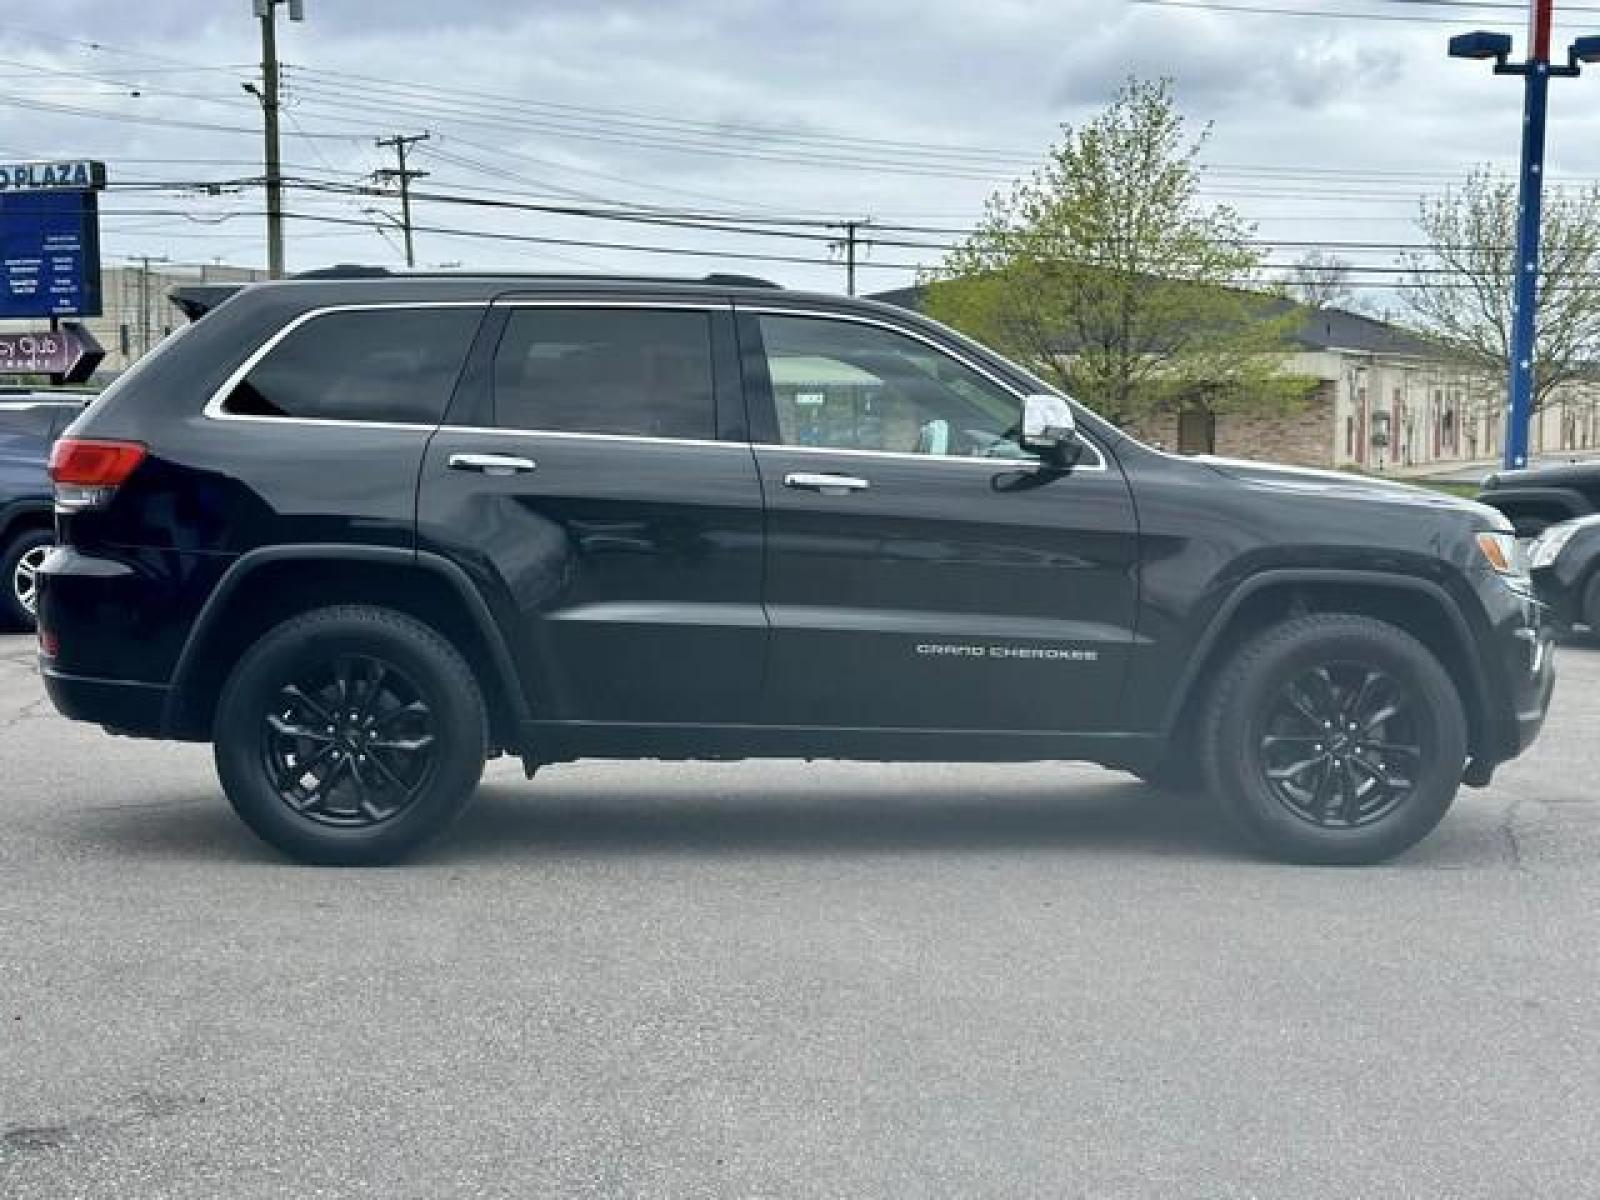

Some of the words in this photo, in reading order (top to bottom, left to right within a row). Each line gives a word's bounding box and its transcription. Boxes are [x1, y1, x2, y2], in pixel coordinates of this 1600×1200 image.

[15, 163, 89, 188] PLAZA
[19, 336, 58, 368] Club
[915, 643, 986, 657] GRAND
[989, 646, 1099, 662] CHEROKEE
